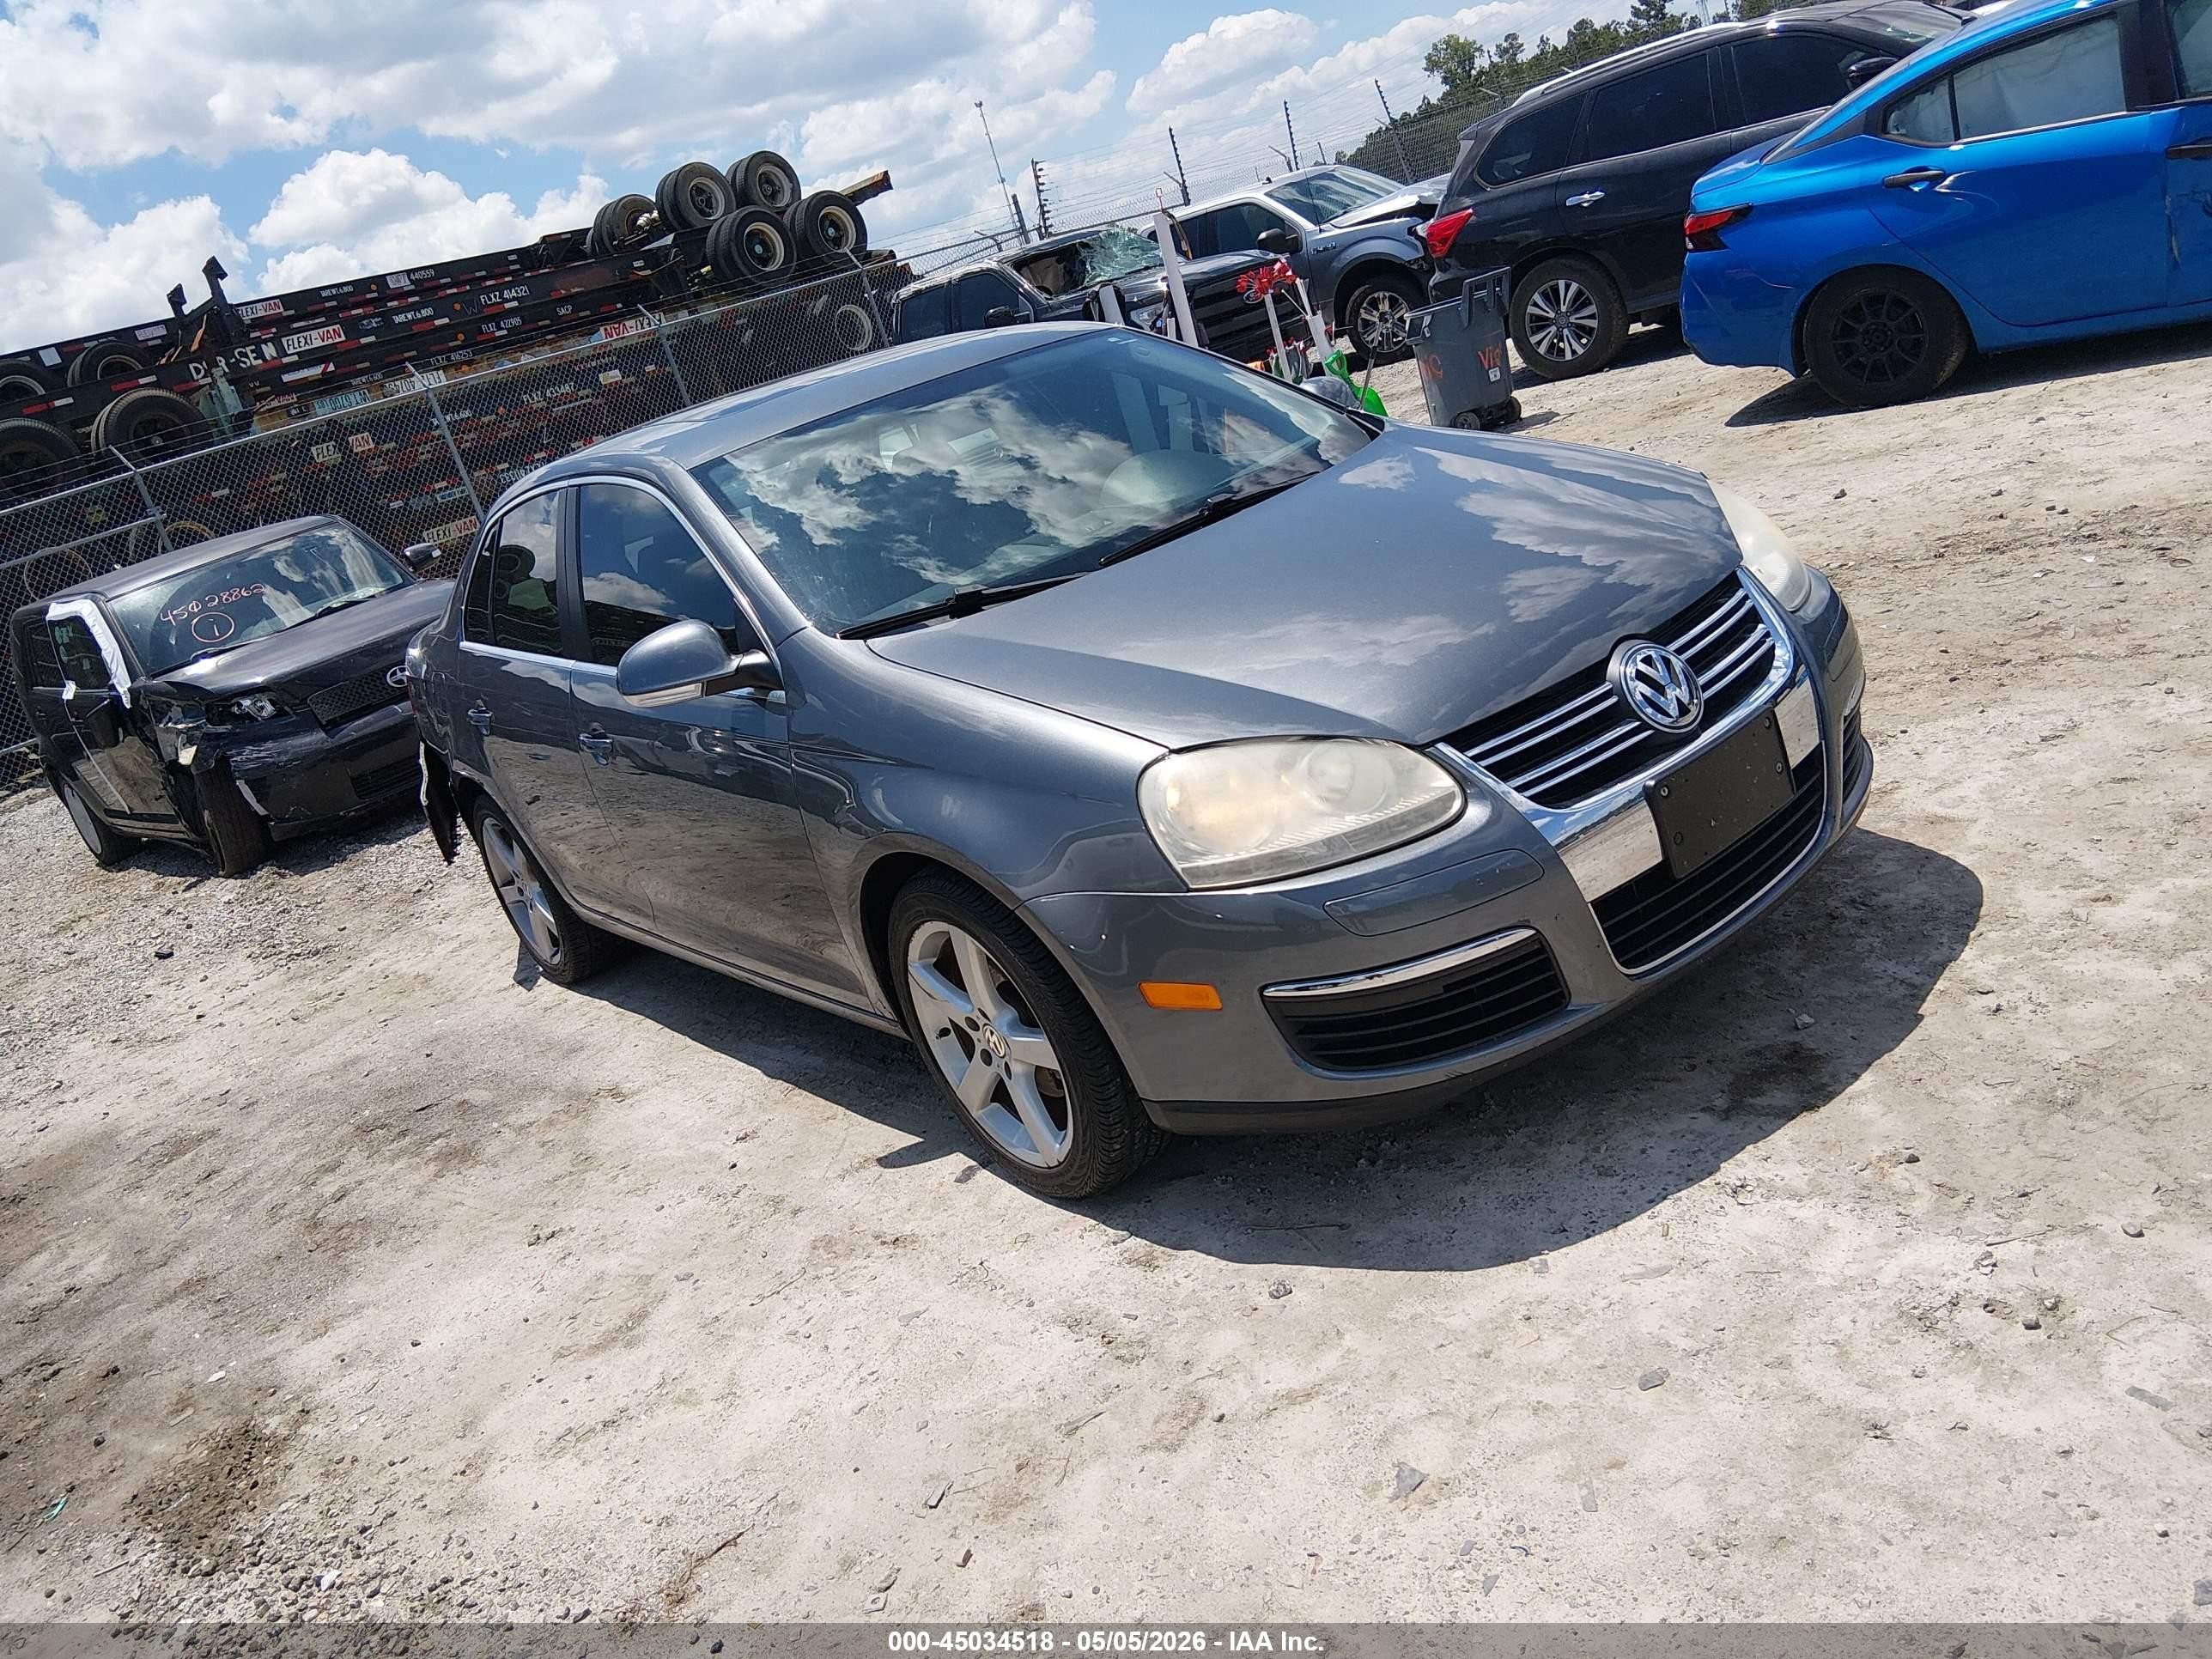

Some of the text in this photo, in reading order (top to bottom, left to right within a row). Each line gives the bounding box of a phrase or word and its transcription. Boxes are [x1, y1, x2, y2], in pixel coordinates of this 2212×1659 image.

[480, 284, 530, 306] FLXZ 414321
[556, 305, 573, 317] SACP
[481, 316, 523, 334] FLXZ 422905
[286, 327, 343, 351] FLEXI-VAN
